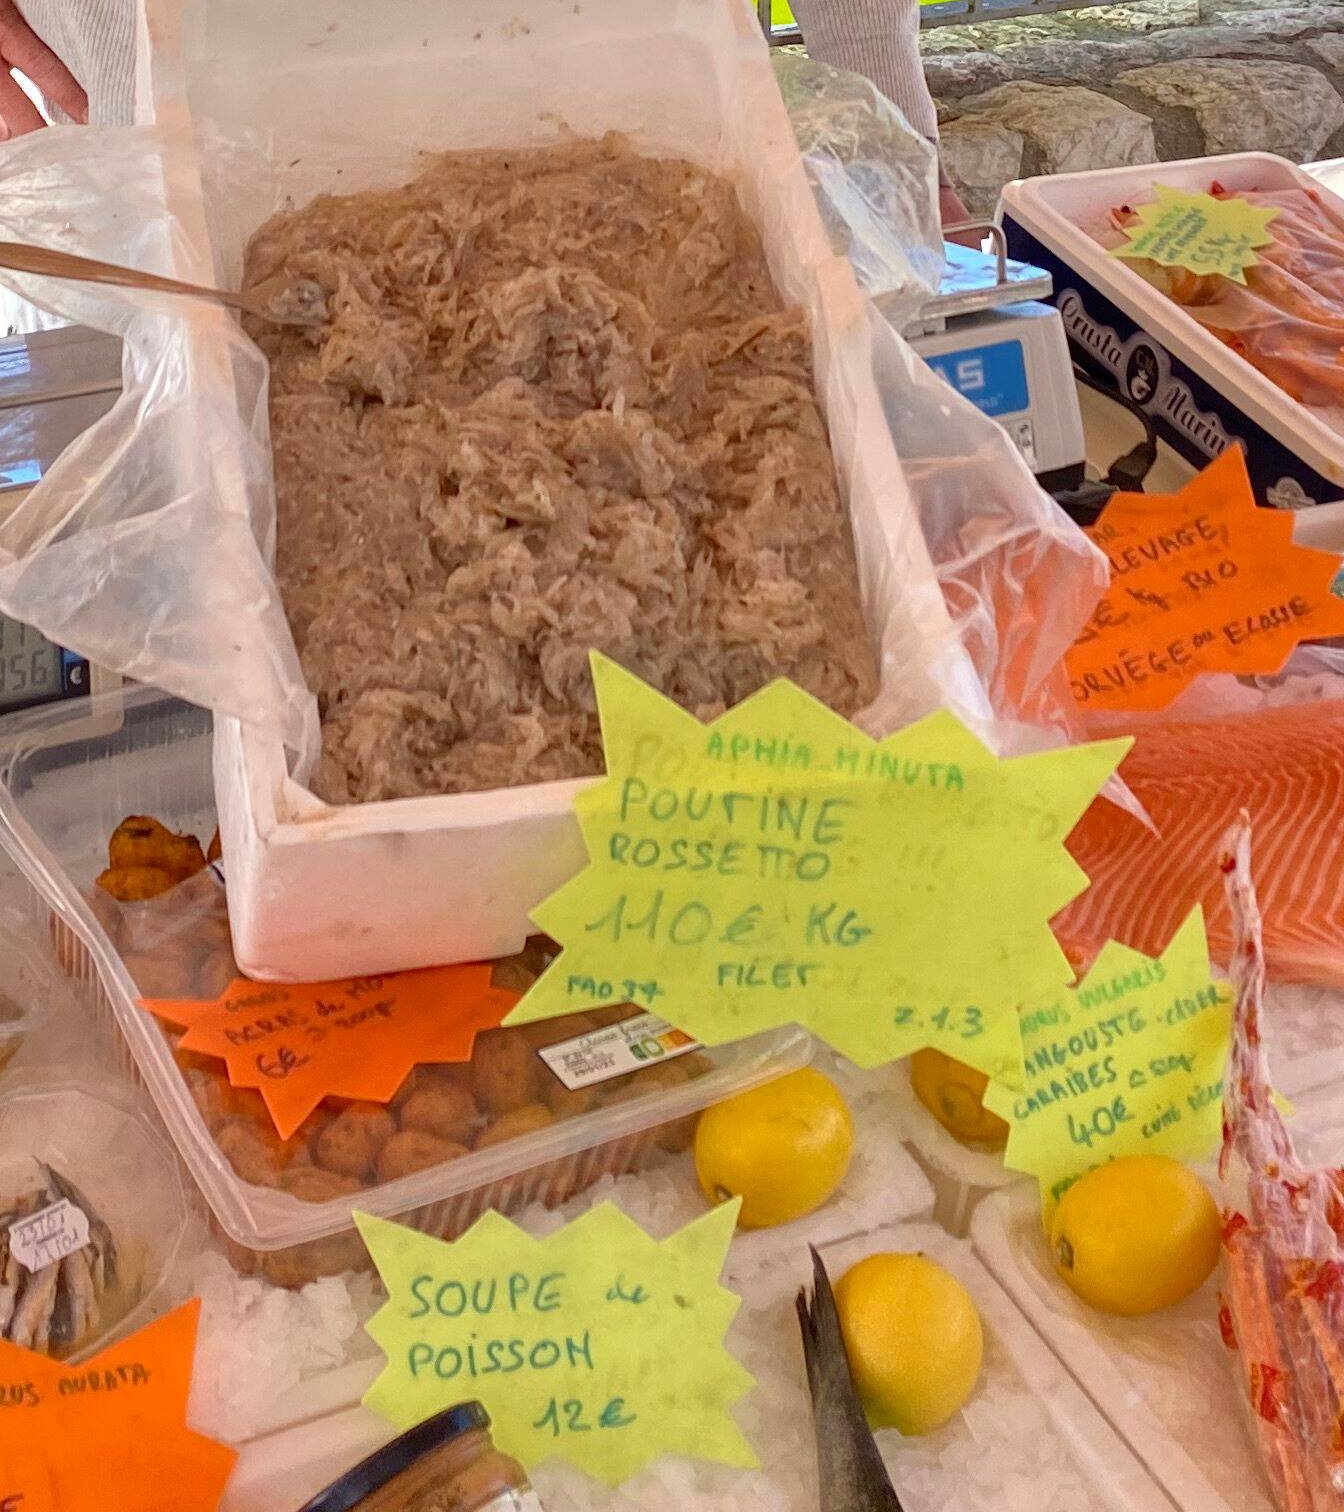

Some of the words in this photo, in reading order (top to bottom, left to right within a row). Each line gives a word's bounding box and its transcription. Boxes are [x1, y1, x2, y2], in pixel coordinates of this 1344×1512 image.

[1164, 386, 1230, 458] Marin
[1108, 518, 1219, 579] LEVAGE
[708, 730, 814, 770] APHIA
[835, 744, 965, 792] MINUTA
[619, 776, 856, 846] POUTINE
[608, 832, 833, 882] ROSSETTO
[804, 901, 875, 947] KG
[716, 957, 827, 990] FILET
[407, 1271, 567, 1320] SOUPE
[604, 1273, 653, 1305] de
[407, 1330, 596, 1380] POISSON
[532, 1397, 639, 1438] 12€
